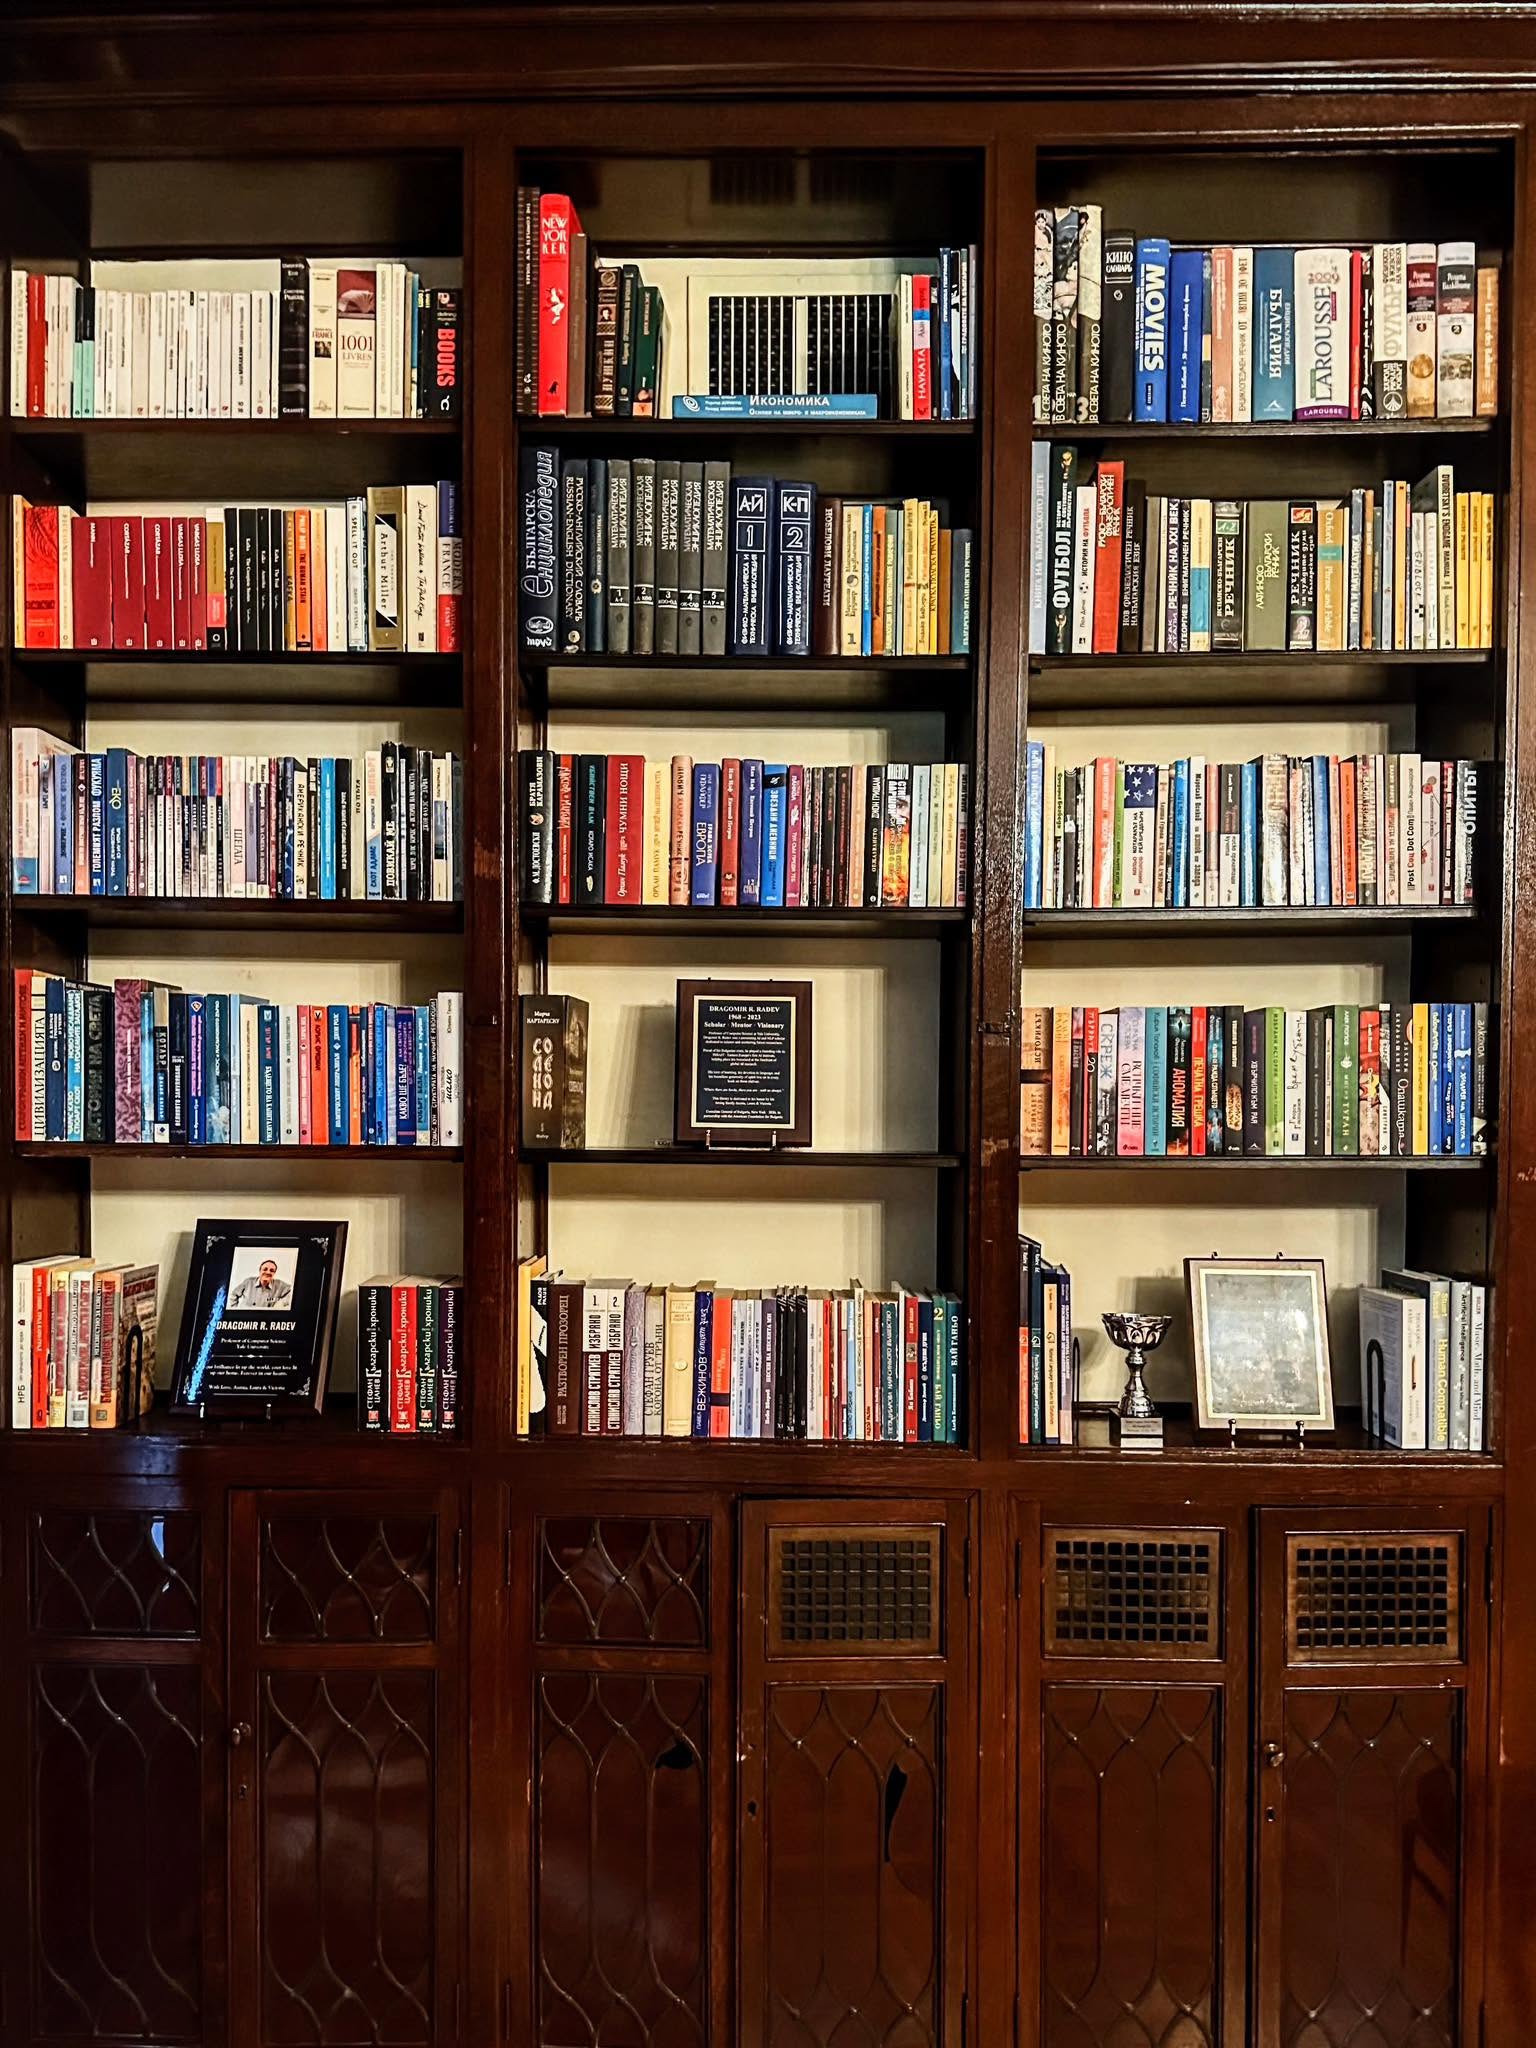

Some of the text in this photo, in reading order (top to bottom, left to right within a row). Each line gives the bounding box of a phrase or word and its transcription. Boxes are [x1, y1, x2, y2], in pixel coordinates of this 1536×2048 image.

[542, 217, 568, 229] NEW
[1105, 250, 1134, 263] КИНО
[341, 335, 374, 351] 1001
[1042, 323, 1051, 366] КИНОТО
[1056, 323, 1067, 367] КИНОТО
[1144, 263, 1165, 372] MOVIES
[1269, 288, 1282, 378] БЪЛГАРИЯ
[1313, 286, 1333, 402] LAROUSSE
[343, 353, 373, 361] LIVRES
[437, 329, 456, 387] BOOKS
[916, 348, 927, 399] НАУКАТА
[1042, 368, 1051, 381] НА
[1056, 369, 1067, 383] НА
[1089, 323, 1100, 421] В СВЕТА НА КИНОТО
[1042, 384, 1051, 411] СВЕТА
[1056, 384, 1067, 412] СВЕТА
[1076, 395, 1089, 420] 3
[1303, 408, 1344, 417] LAROUSSE
[525, 489, 536, 570] БЪЛГАРСКА
[611, 478, 619, 548] МАТЕМАТИЧЕСКАЯ
[619, 478, 627, 549] ЭНЦИКЛОПЕДИЯ
[636, 475, 644, 546] МАТЕМАТИЧЕСКАЯ
[644, 475, 653, 547] ЭНЦИКЛОПЕДИЯ
[661, 479, 670, 550] МАТЕМАТИЧЕСКАЯ
[670, 479, 679, 550] ЭНЦИКЛОПЕДИЯ
[683, 481, 693, 552] МАТЕМАТИЧЕСКАЯ
[692, 481, 701, 553] ЭНЦИКЛОПЕДИЯ
[707, 480, 716, 551] МАТЕМАТИЧЕСКАЯ
[715, 480, 724, 551] ЭНЦИКЛОПЕДИЯ
[783, 496, 809, 513] К-П
[786, 526, 803, 548] 2
[1325, 512, 1334, 544] Oxford
[1442, 474, 1452, 578] DVORETSKY'S ENDGAME MANUAL
[351, 541, 358, 550] IT
[380, 532, 389, 609] Arthur Miller
[441, 542, 451, 588] FRANCE
[565, 476, 574, 619] RUSSIAN-ENGLISH DICTIONARY
[823, 508, 833, 606] НОБЕЛОВИ ЛАУРЕАТИ
[1052, 530, 1072, 609] ФУТБОЛ
[1081, 508, 1090, 577] ИСТОРИЯ НА ФУТБОЛА
[1167, 502, 1179, 609] РЕЧНИК НА XXI ВЕК
[1271, 546, 1280, 578] РЕЧНИК
[1291, 531, 1300, 606] РЕЧНИК
[299, 553, 307, 604] THE HUMAN STAIN
[1131, 542, 1141, 626] НА БЪЛГАРСКИЯ ЕЗИК
[1224, 537, 1235, 617] РЕЧНИК
[109, 787, 122, 810] ЕКО
[536, 756, 544, 807] КАРАМАЗОВИ
[619, 763, 629, 833] ЧУМНИ НОЩИ
[1463, 767, 1477, 835] ОПИТЪТ
[233, 828, 243, 865] ШЕГАТА
[297, 783, 306, 868] АМЕРИКАНСКИ РЕЧНИК
[385, 820, 396, 887] ПОВИКАЙ МЕ
[695, 822, 707, 866] ЕВРОПА
[769, 789, 779, 860] ЗВЕЗДНИ ДНЕВНИЦИ
[1406, 819, 1416, 887] Post Соц Dot Com
[757, 1022, 784, 1030] Visionary
[1034, 1013, 1043, 1064] ИСТОРИКЪТ
[1099, 1023, 1114, 1080] СКРЕЖ
[34, 1016, 46, 1137] ЦИВИЛИЗАЦИЯТА
[398, 1063, 408, 1120] КАКВО ЩЕ БЪДЕ?
[1171, 1068, 1186, 1127] АНОМАЛИЯ
[1193, 1056, 1205, 1128] ПЕЧАТНА ГРЕШКА
[1250, 1060, 1258, 1124] ХВЪРЧИЛО КЪМ РАЯ
[1395, 1078, 1409, 1139] Опашката
[1342, 1102, 1350, 1136] ТУРАН
[216, 1321, 297, 1331] DRAGOMIR R. RADEV
[365, 1288, 382, 1378] Български хроники
[395, 1290, 412, 1379] Български хроники
[419, 1288, 435, 1377] Български хроники
[442, 1290, 457, 1379] Български хроники
[558, 1294, 569, 1397] РАЗТВОРЕН ПРОЗОРЕЦ
[950, 1315, 959, 1366] БАЙ ГАНЬО
[1458, 1323, 1467, 1361] Intelligence
[366, 1378, 374, 1410] СТЕФАН
[442, 1379, 450, 1410] СТЕФАН
[644, 1342, 655, 1417] СТЕФАН ГРУЕВ
[654, 1323, 663, 1416] КОРОНА ОТ ТРЪНИ
[1436, 1339, 1448, 1442] Human Compatible
[1472, 1322, 1482, 1421] Music, Math, and Mind
[934, 1383, 942, 1430] БАЙ ГАНЬО
